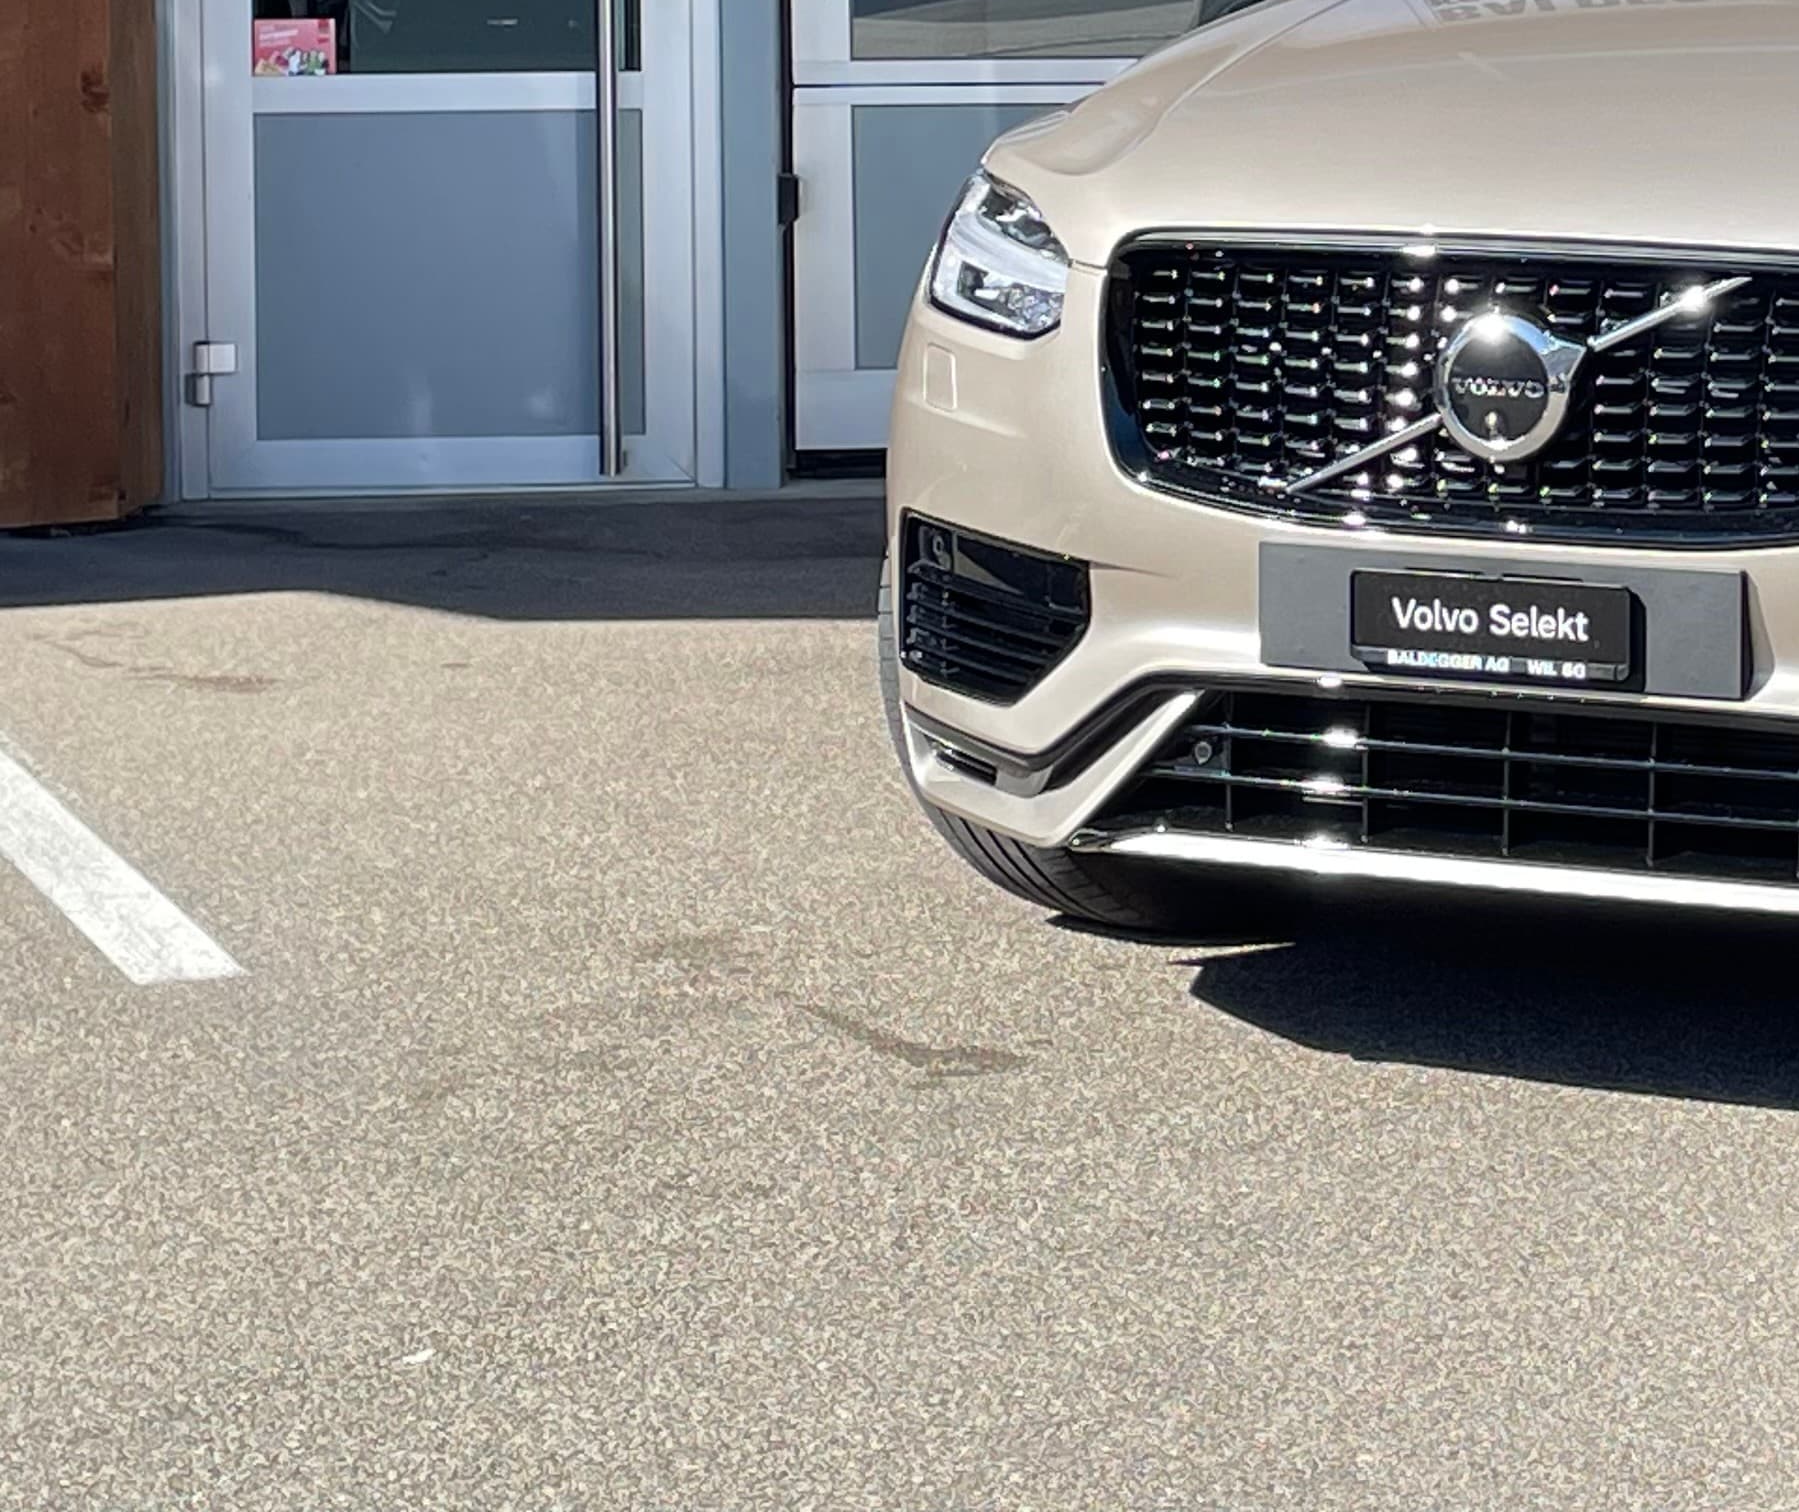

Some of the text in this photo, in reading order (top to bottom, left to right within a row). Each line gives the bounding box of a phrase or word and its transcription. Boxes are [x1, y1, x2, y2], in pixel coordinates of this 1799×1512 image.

[1451, 376, 1545, 398] VOLVO
[1391, 595, 1590, 642] Volvo Selekt
